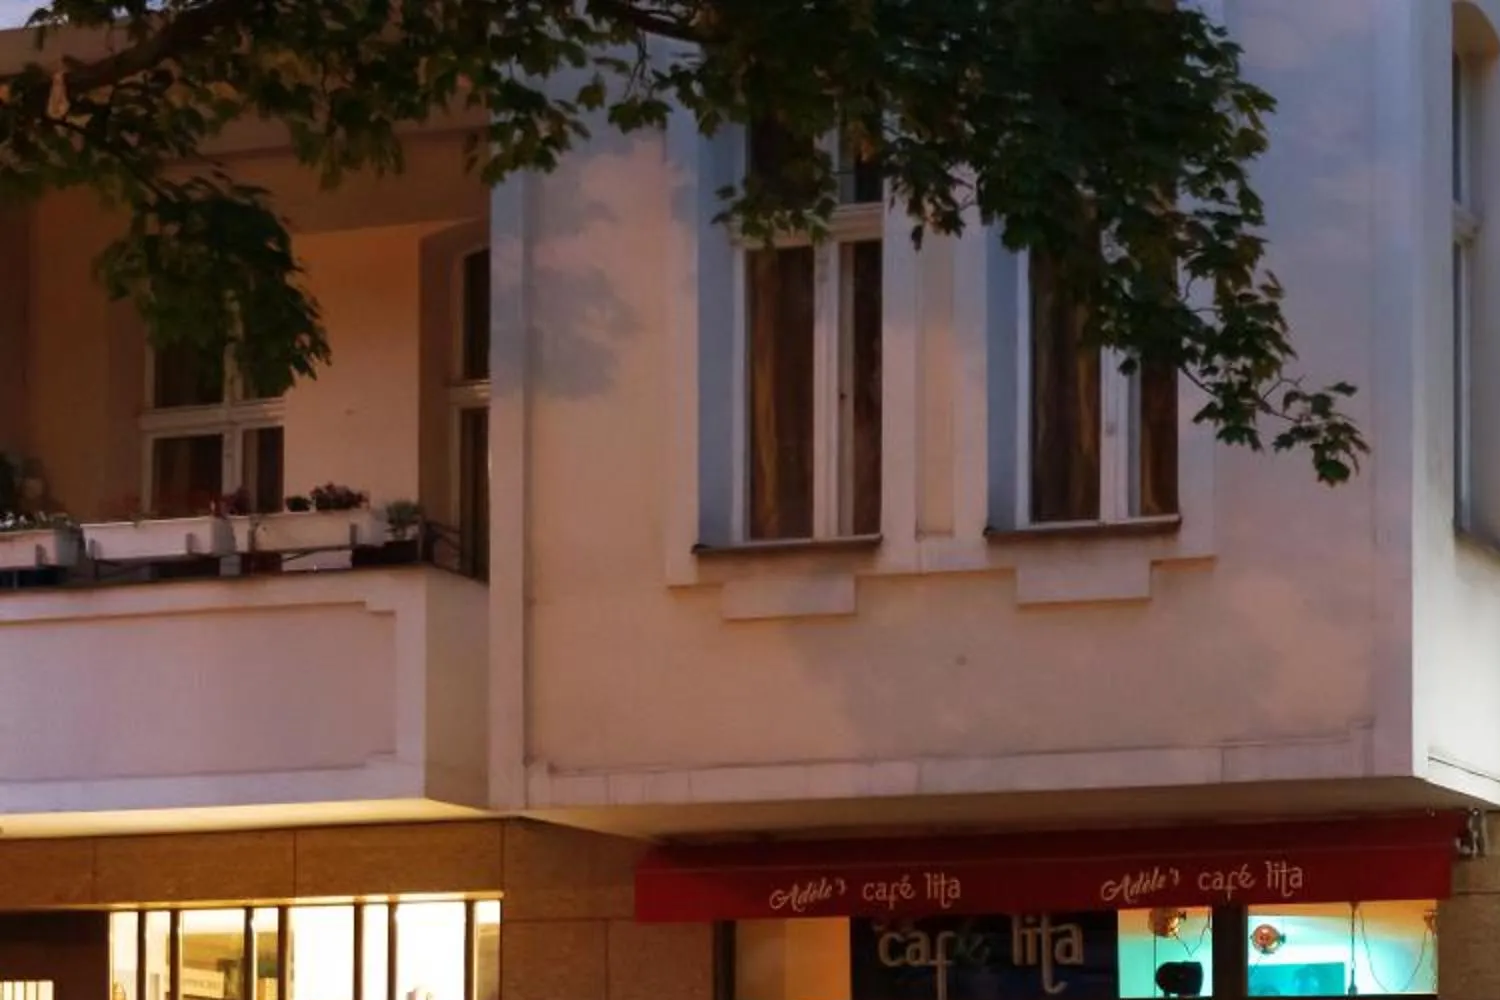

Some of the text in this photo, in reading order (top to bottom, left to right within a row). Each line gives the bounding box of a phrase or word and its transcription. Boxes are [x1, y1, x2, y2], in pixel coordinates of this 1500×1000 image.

[862, 875, 916, 910] café
[924, 872, 961, 909] lita
[1197, 864, 1254, 901] café
[1265, 860, 1303, 897] lita
[1011, 915, 1084, 994] lita
